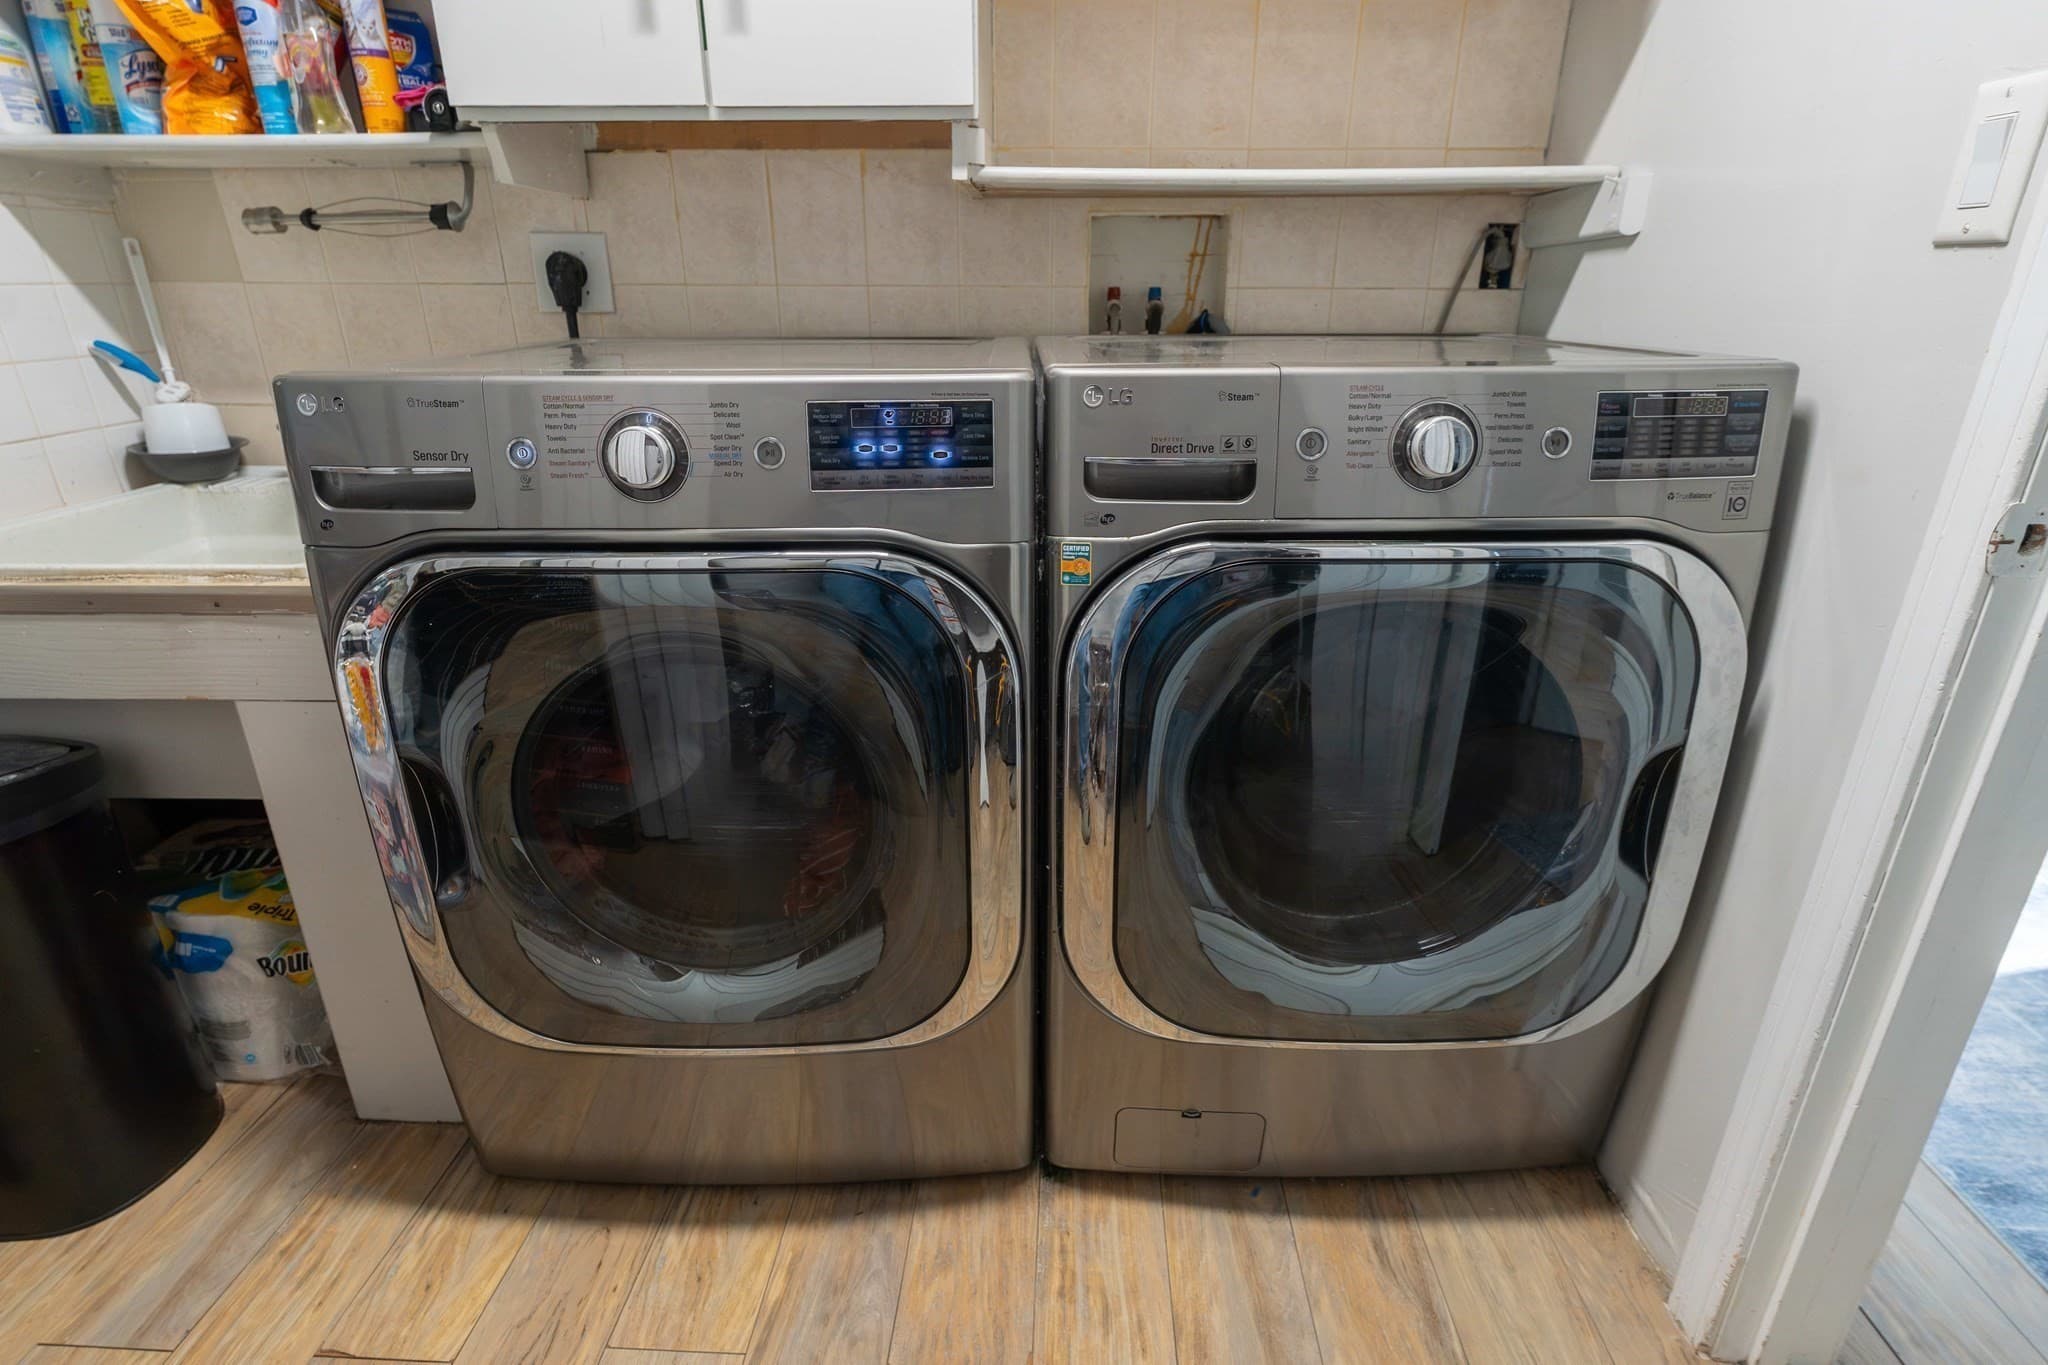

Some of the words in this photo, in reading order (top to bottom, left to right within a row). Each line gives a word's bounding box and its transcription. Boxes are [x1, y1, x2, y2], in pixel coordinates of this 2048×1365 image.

[1108, 387, 1134, 405] LG
[1347, 414, 1383, 422] Bulky/Large
[545, 423, 562, 431] Heavy
[563, 423, 577, 431] Duty
[1348, 426, 1364, 434] Bright
[546, 434, 567, 442] Towels
[710, 433, 724, 441] Spot
[1347, 438, 1371, 446] Sanitary
[731, 444, 742, 452] Dry
[1151, 442, 1184, 454] Direct
[1186, 442, 1215, 454] Drive
[412, 450, 448, 462] Sensor
[450, 450, 469, 466] Dry
[1346, 462, 1356, 470] Tub
[1357, 462, 1374, 470] Clean
[733, 471, 744, 479] Dry
[1727, 496, 1747, 513] 10
[248, 902, 296, 921] Triple
